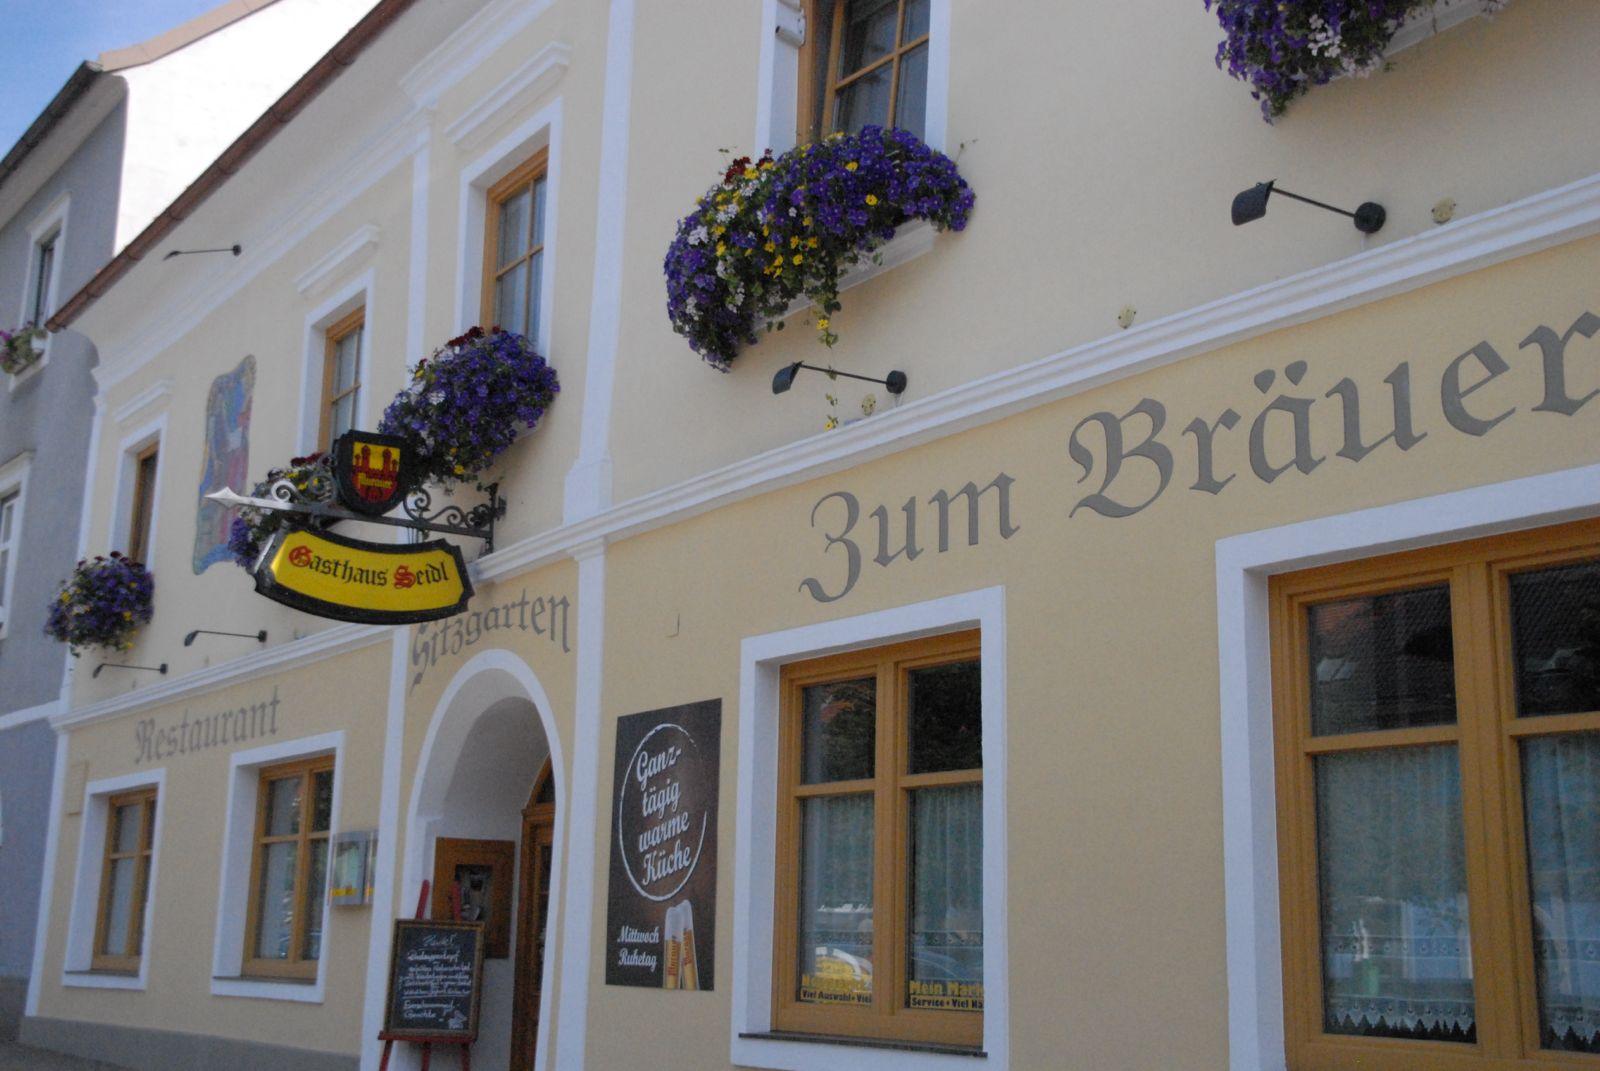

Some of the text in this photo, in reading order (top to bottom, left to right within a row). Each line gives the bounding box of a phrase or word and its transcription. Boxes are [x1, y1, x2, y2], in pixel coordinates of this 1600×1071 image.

[799, 310, 1600, 603] Zum Bräuer
[288, 546, 449, 589] Gasthaus Seidl
[134, 685, 280, 764] Restaurant
[636, 745, 681, 791] Ganz-
[642, 778, 680, 819] tägig
[638, 811, 690, 853] warme
[642, 839, 691, 886] Küche
[617, 925, 659, 944] Mittwoch
[618, 947, 657, 973] Ruhetag
[911, 997, 945, 1009] Service
[952, 998, 968, 1009] Viel
